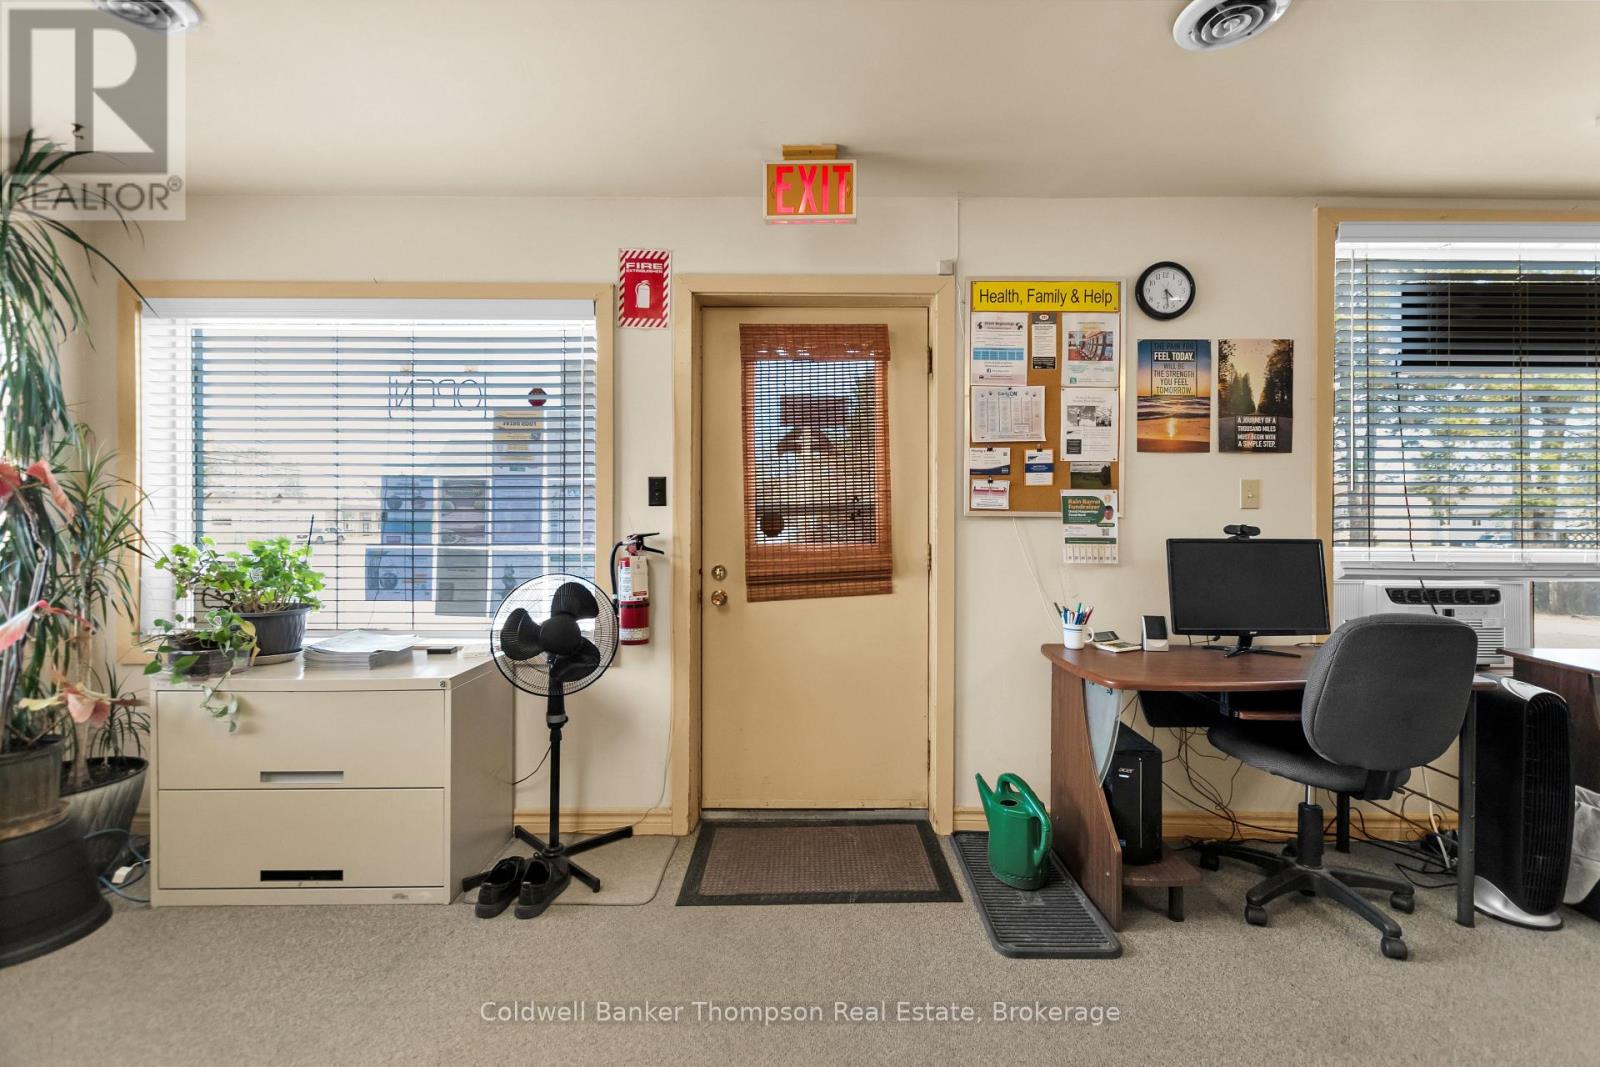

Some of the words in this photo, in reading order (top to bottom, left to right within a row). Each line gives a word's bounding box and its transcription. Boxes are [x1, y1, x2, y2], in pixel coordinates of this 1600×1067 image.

[775, 165, 852, 214] EXIT
[625, 262, 663, 270] FIRE
[979, 288, 1023, 304] Health,
[1027, 288, 1067, 307] Family
[1071, 289, 1080, 304] &
[1084, 289, 1113, 307] Help
[1154, 352, 1170, 361] FEEL
[1171, 351, 1194, 361] TODAY.
[1154, 370, 1165, 378] THE
[1165, 370, 1195, 378] STRENGTH
[1160, 378, 1173, 386] YOU
[1174, 378, 1189, 386] FEEL
[1237, 416, 1242, 424] A
[1272, 416, 1277, 424] A
[1237, 440, 1242, 448] A
[1243, 440, 1262, 448] SIMPLE
